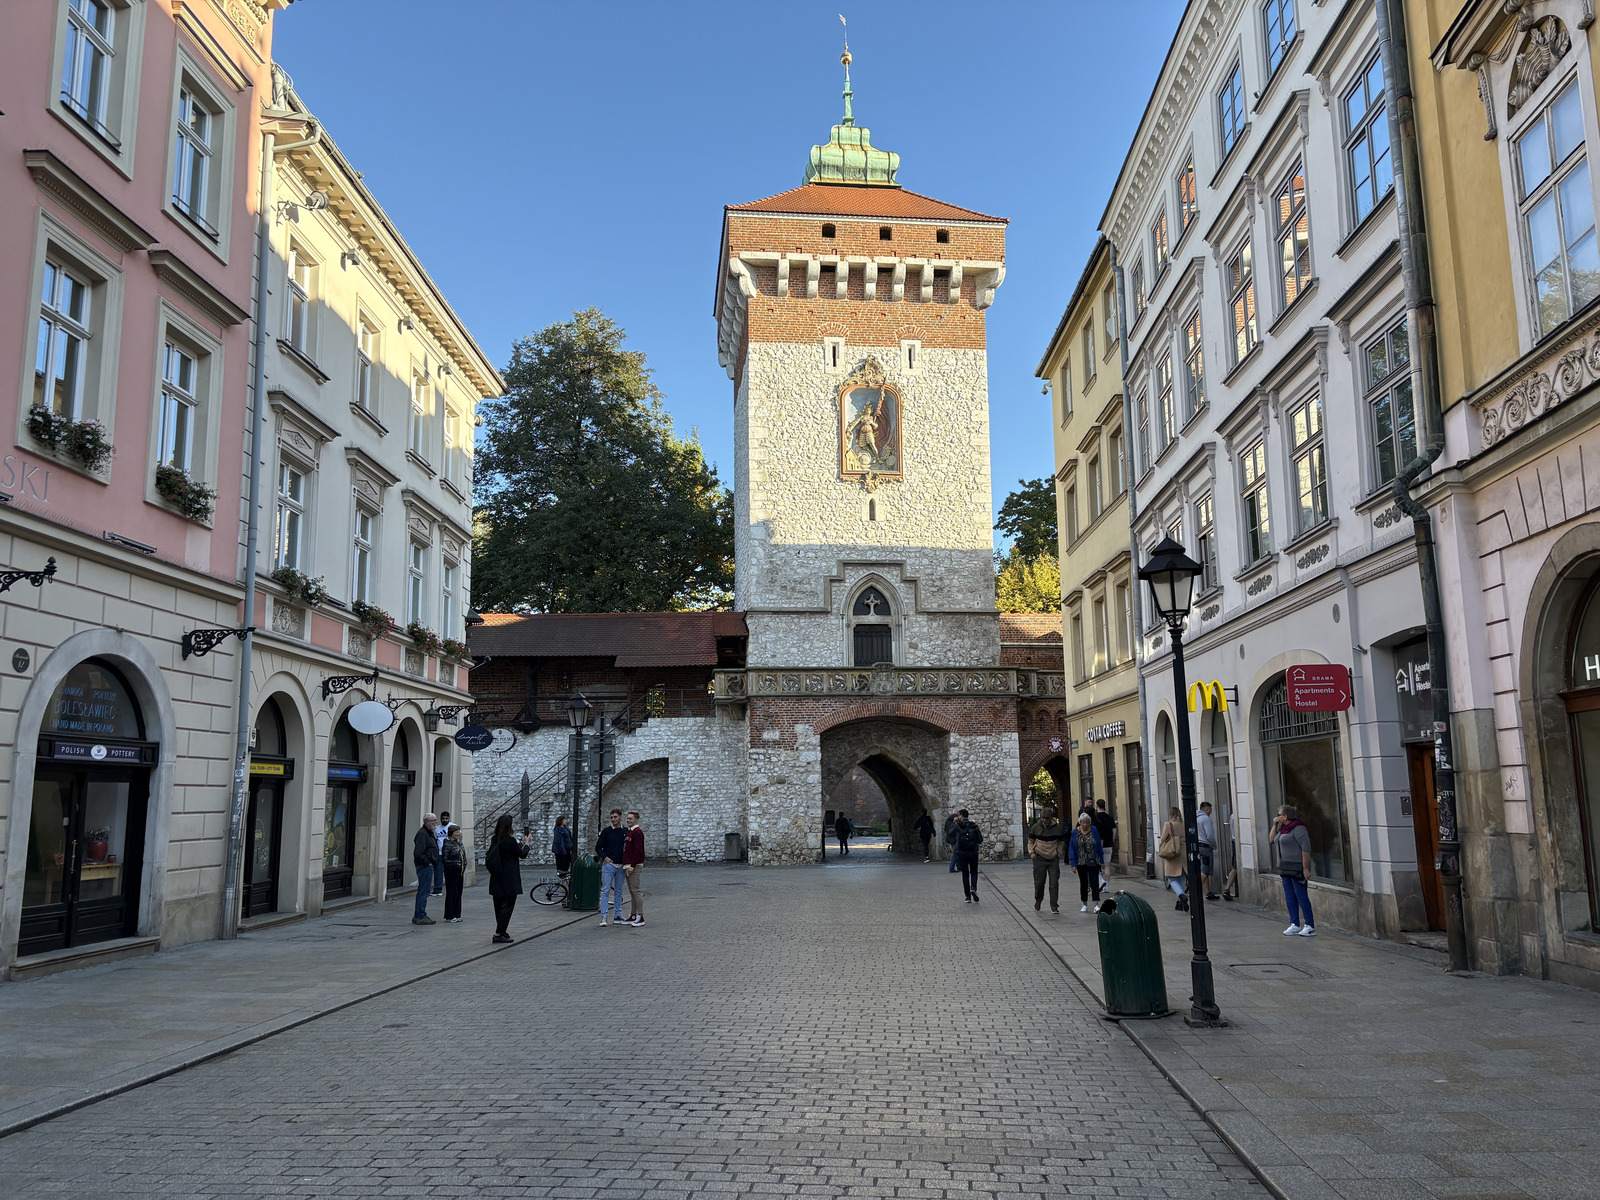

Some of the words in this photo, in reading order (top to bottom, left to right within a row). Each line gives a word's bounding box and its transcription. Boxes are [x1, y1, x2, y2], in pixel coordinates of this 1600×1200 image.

[1, 455, 51, 502] SKI
[1415, 662, 1430, 673] Apart
[1416, 681, 1431, 691] Hoste
[93, 690, 116, 701] POTTERY
[53, 699, 116, 720] BOLESŁAWIEC
[52, 719, 69, 729] HAND
[69, 720, 86, 731] MADE
[86, 723, 92, 731] IN
[93, 723, 114, 733] POLAND
[1103, 721, 1122, 738] COFFEE
[61, 746, 85, 754] POLISH
[111, 750, 135, 758] POTTERY
